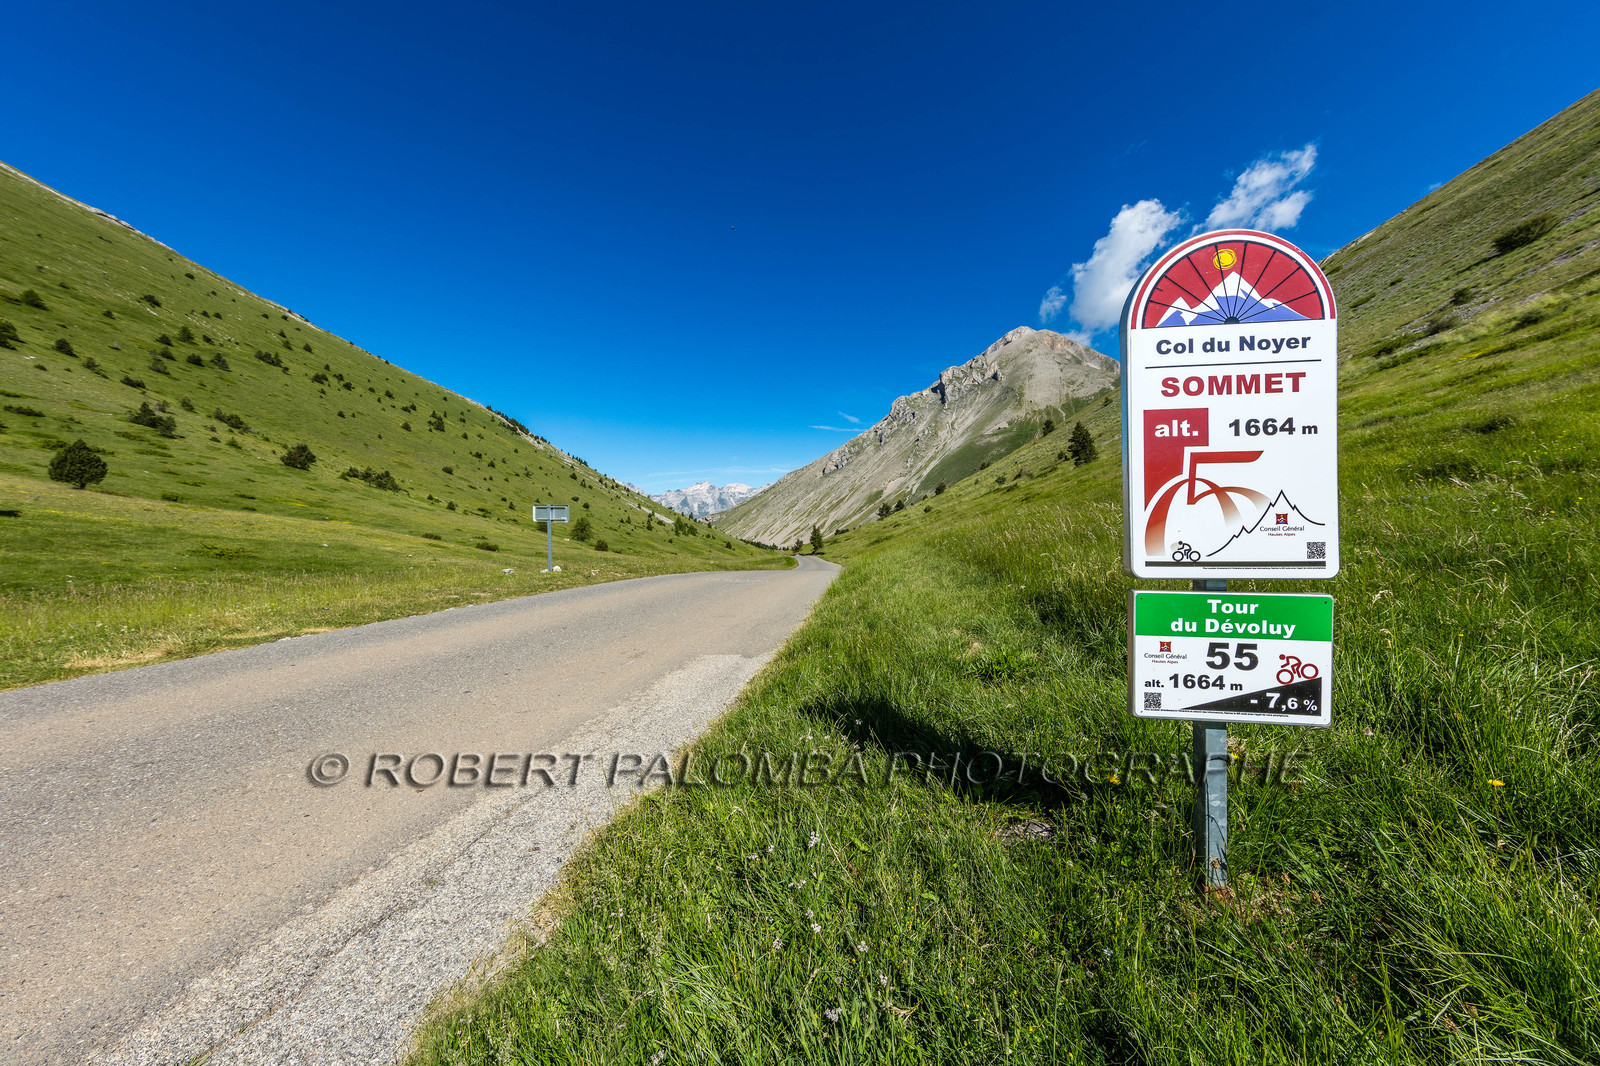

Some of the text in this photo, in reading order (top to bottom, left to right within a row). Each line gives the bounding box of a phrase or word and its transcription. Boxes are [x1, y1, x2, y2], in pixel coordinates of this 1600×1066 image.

[1156, 335, 1311, 355] Col du Noyer
[1161, 372, 1306, 397] SOMMET
[1154, 417, 1318, 437] alt. 1664 m
[1207, 599, 1259, 615] Tour
[1170, 618, 1296, 639] du Dévoluy
[1205, 642, 1259, 671] 55
[1144, 673, 1243, 691] alt. 1664 m
[1266, 692, 1298, 712] 7,6
[1303, 699, 1318, 712] %
